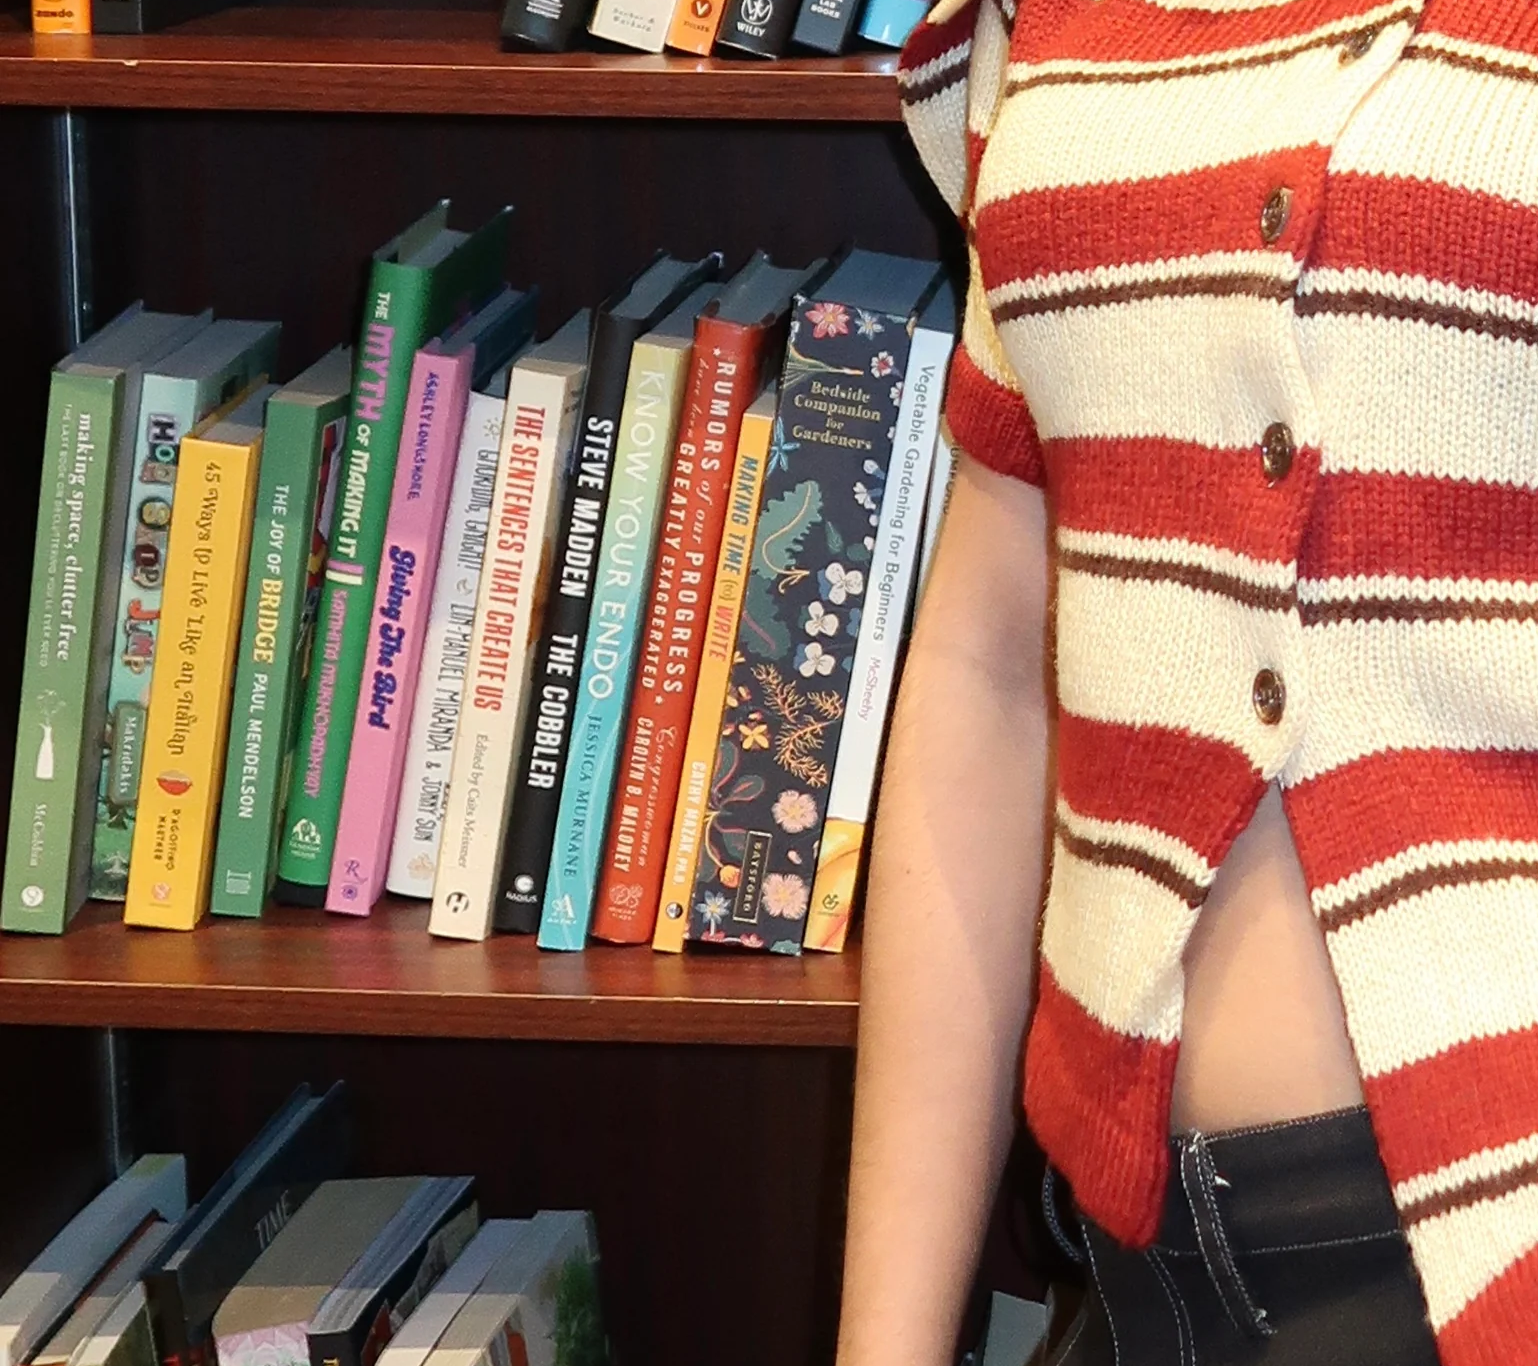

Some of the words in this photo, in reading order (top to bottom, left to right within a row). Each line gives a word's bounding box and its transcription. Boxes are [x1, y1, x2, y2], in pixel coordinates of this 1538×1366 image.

[736, 21, 766, 37] WILEY
[793, 394, 882, 423] Companion
[810, 380, 871, 402] Bedside
[513, 404, 546, 442] THE
[791, 424, 873, 450] Gardeners
[825, 418, 845, 431] for
[68, 413, 92, 485] making
[577, 416, 614, 492] STEVE
[63, 489, 85, 550] space,
[496, 442, 540, 554] SENTENCES
[559, 496, 602, 598] MADDEN
[60, 552, 84, 620] clutter
[488, 557, 525, 607] THAT
[56, 624, 78, 662] free
[477, 606, 515, 685] CREATE
[545, 633, 579, 678] THE
[473, 685, 505, 712] US
[527, 684, 571, 790] COBBLER
